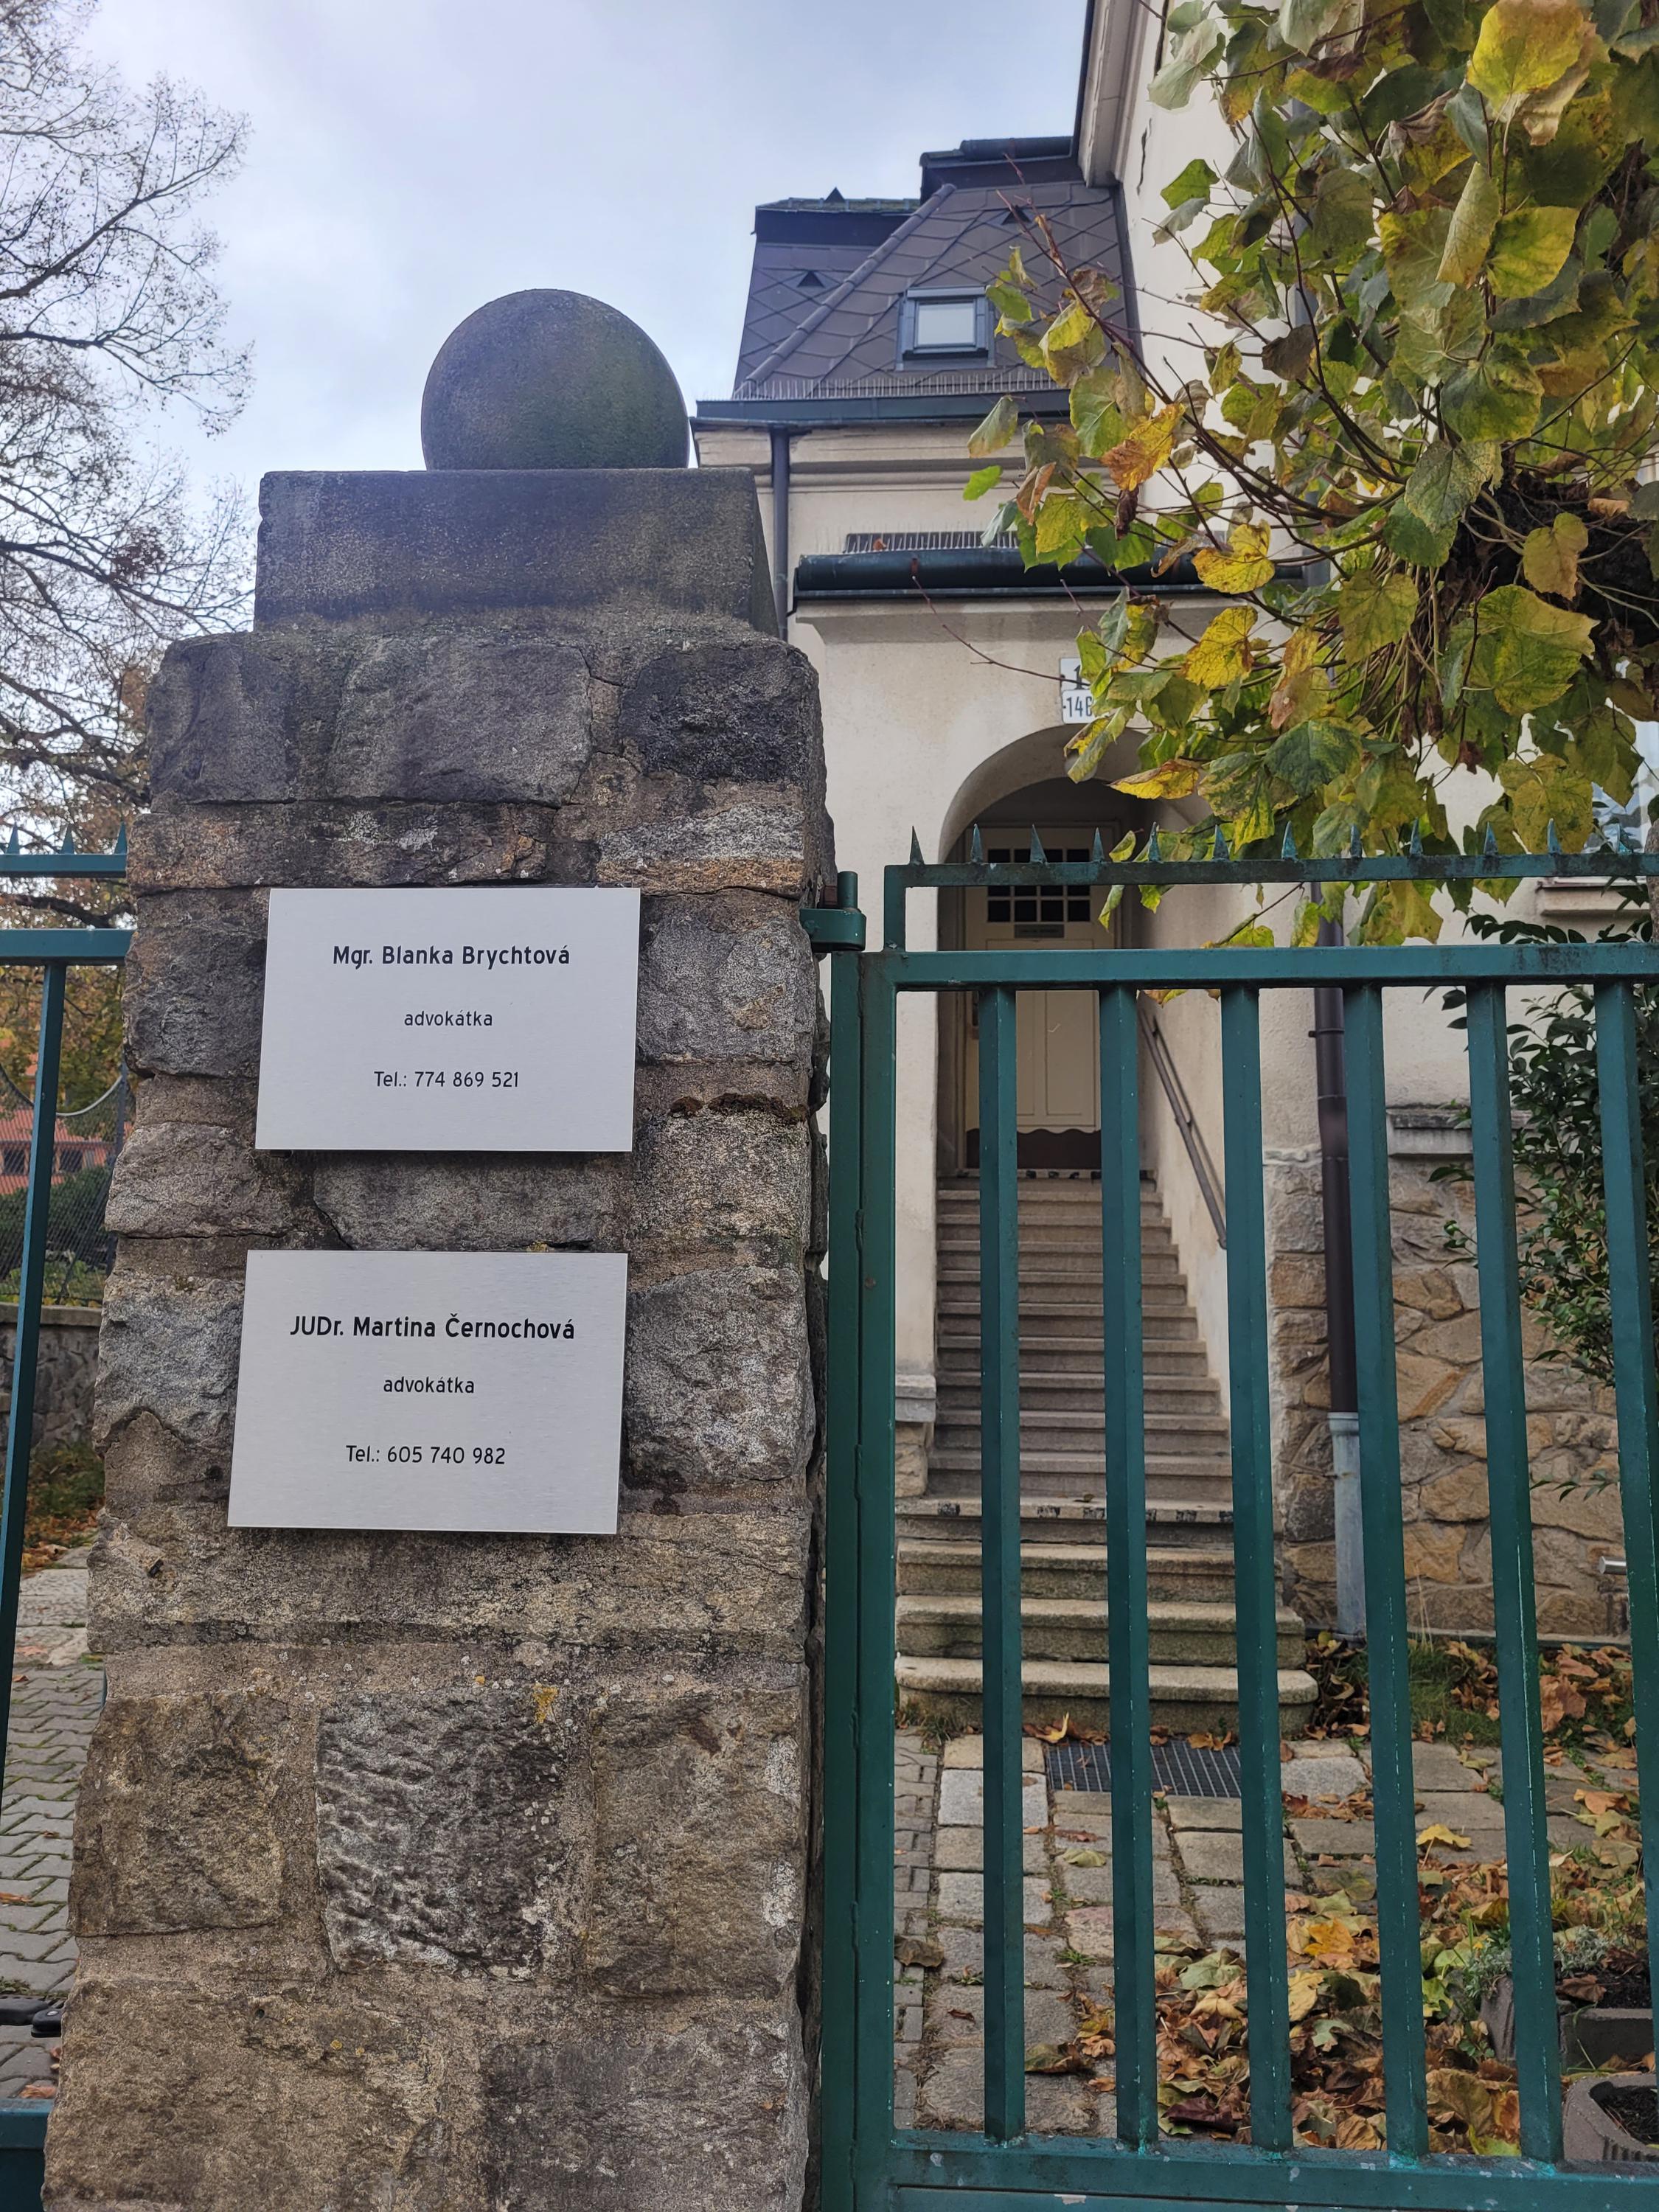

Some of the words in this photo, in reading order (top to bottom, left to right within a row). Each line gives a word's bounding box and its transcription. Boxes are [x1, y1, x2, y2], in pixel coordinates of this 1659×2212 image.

[333, 945, 373, 970] Mgr.
[382, 945, 453, 965] Blanka
[462, 945, 570, 970] Brychtová
[404, 1009, 493, 1026] advokátka
[374, 1071, 407, 1088] Tel.:
[414, 1071, 445, 1088] 774
[453, 1071, 484, 1088] 869
[491, 1071, 519, 1088] 521
[290, 1315, 344, 1336] JUDr.
[353, 1315, 436, 1338] Martina
[445, 1312, 575, 1340] Černochová
[383, 1376, 475, 1394] advokátka
[345, 1444, 380, 1463] Tel.:
[387, 1445, 422, 1464] 605
[430, 1446, 465, 1464] 740
[473, 1447, 506, 1465] 982
